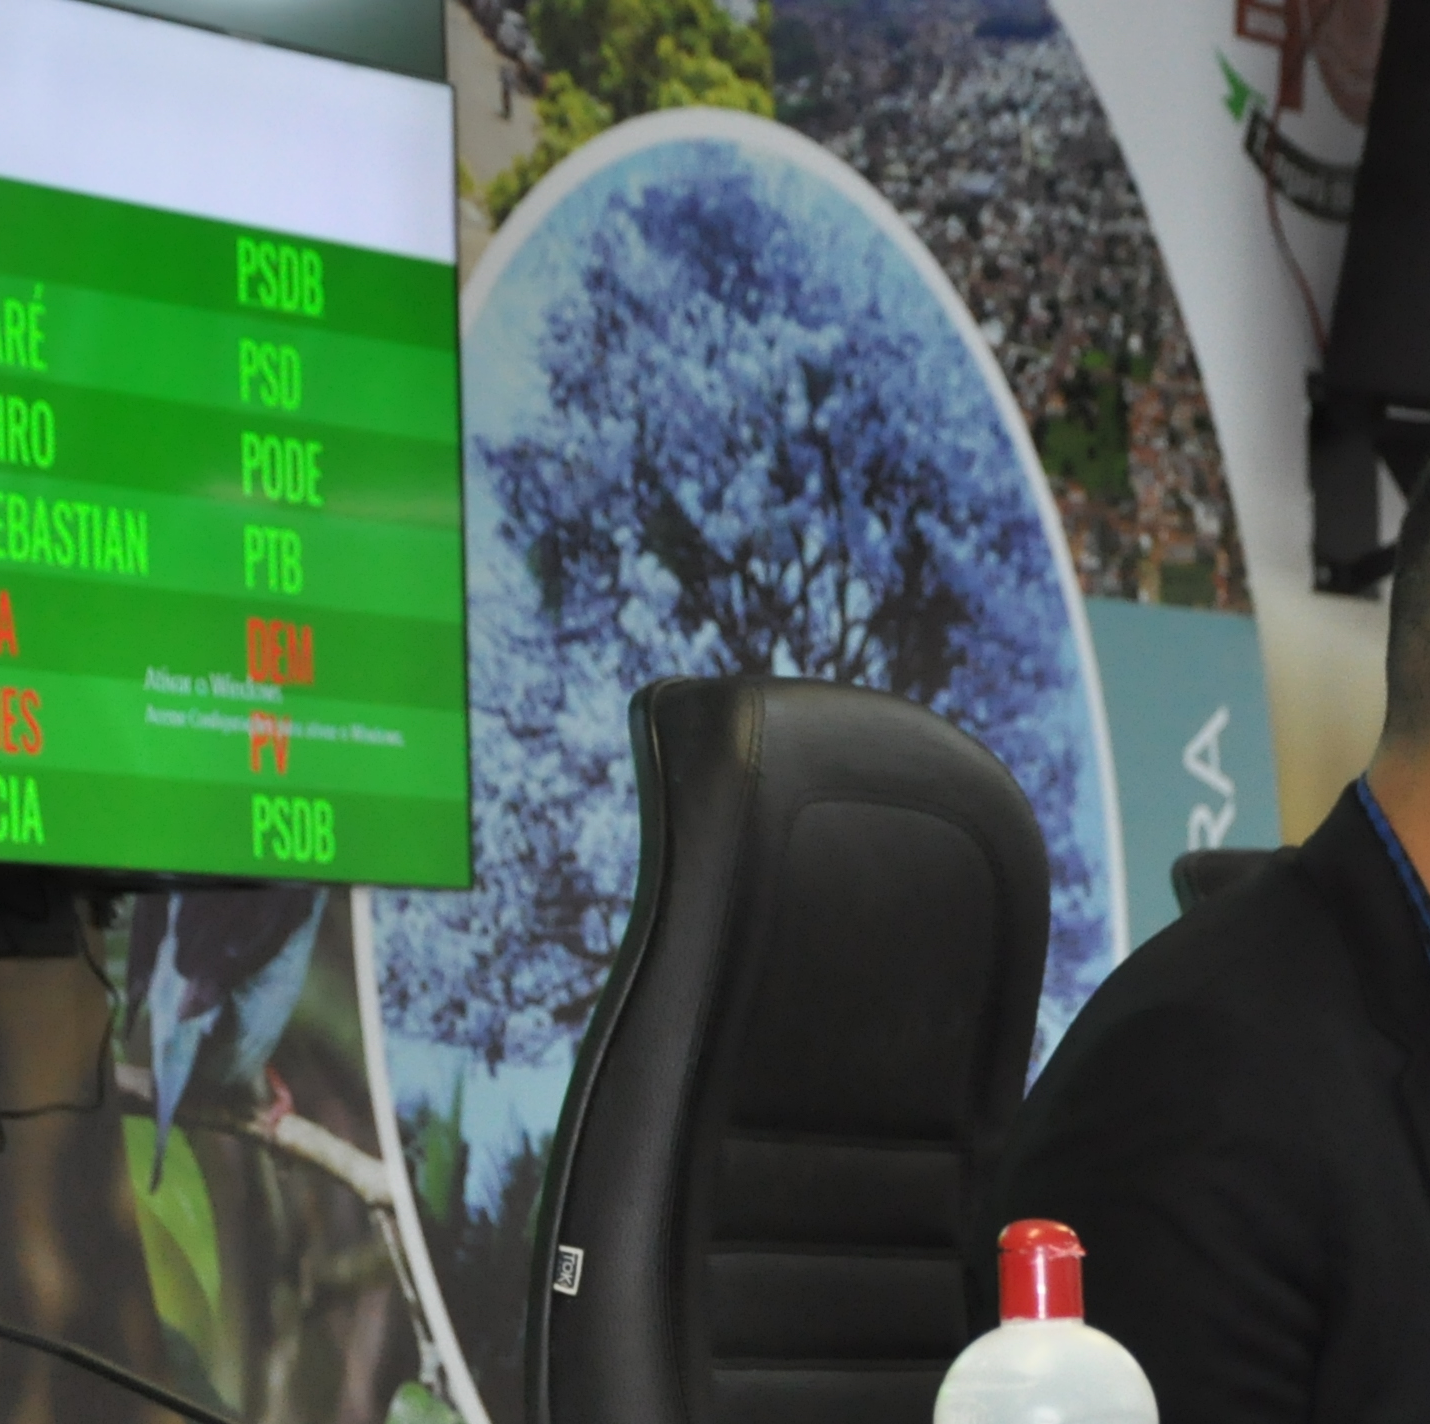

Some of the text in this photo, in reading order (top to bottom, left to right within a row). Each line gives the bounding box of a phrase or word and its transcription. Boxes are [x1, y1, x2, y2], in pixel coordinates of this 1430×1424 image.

[235, 236, 325, 318] PSDB
[238, 337, 303, 412] PSD
[240, 431, 324, 506] PODE
[243, 524, 303, 595] PTB
[246, 616, 315, 686] DEM
[252, 794, 335, 864] PSDB
